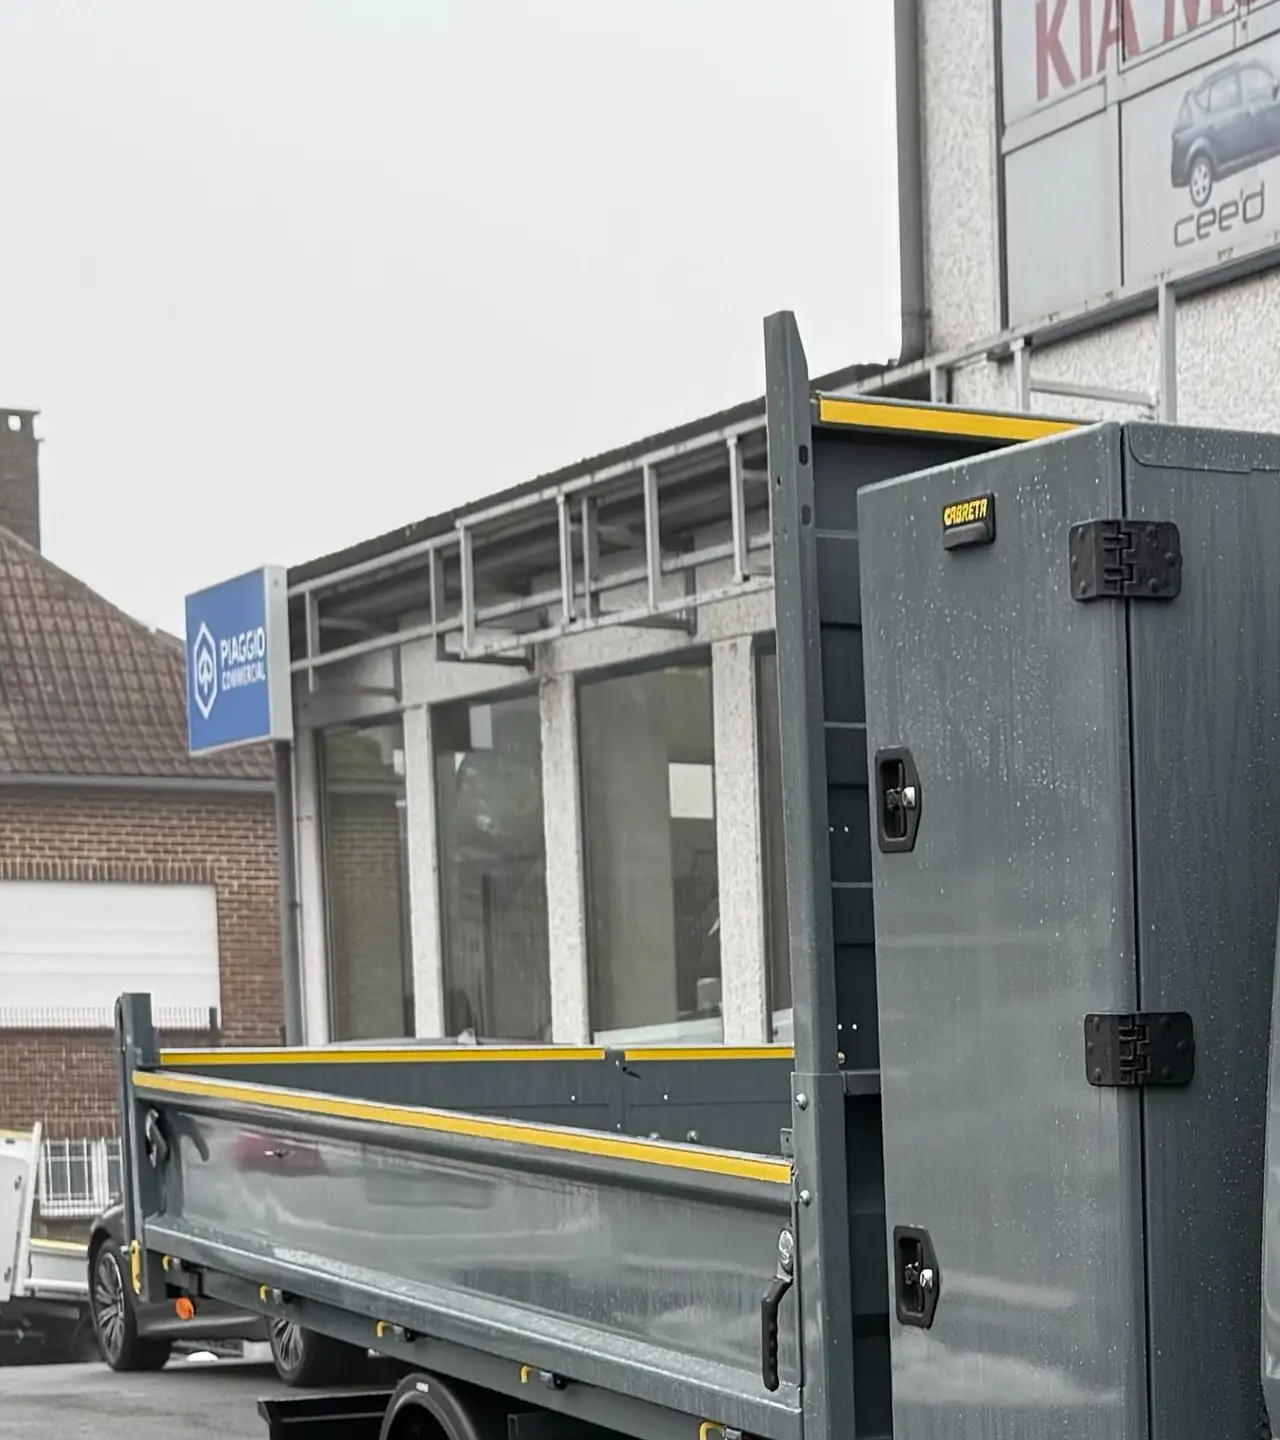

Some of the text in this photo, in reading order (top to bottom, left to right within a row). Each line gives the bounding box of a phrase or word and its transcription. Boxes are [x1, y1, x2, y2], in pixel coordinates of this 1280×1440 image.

[1035, 0, 1141, 102] KIA
[219, 626, 266, 669] PIAGGIO
[222, 660, 267, 691] COMMERCIAL
